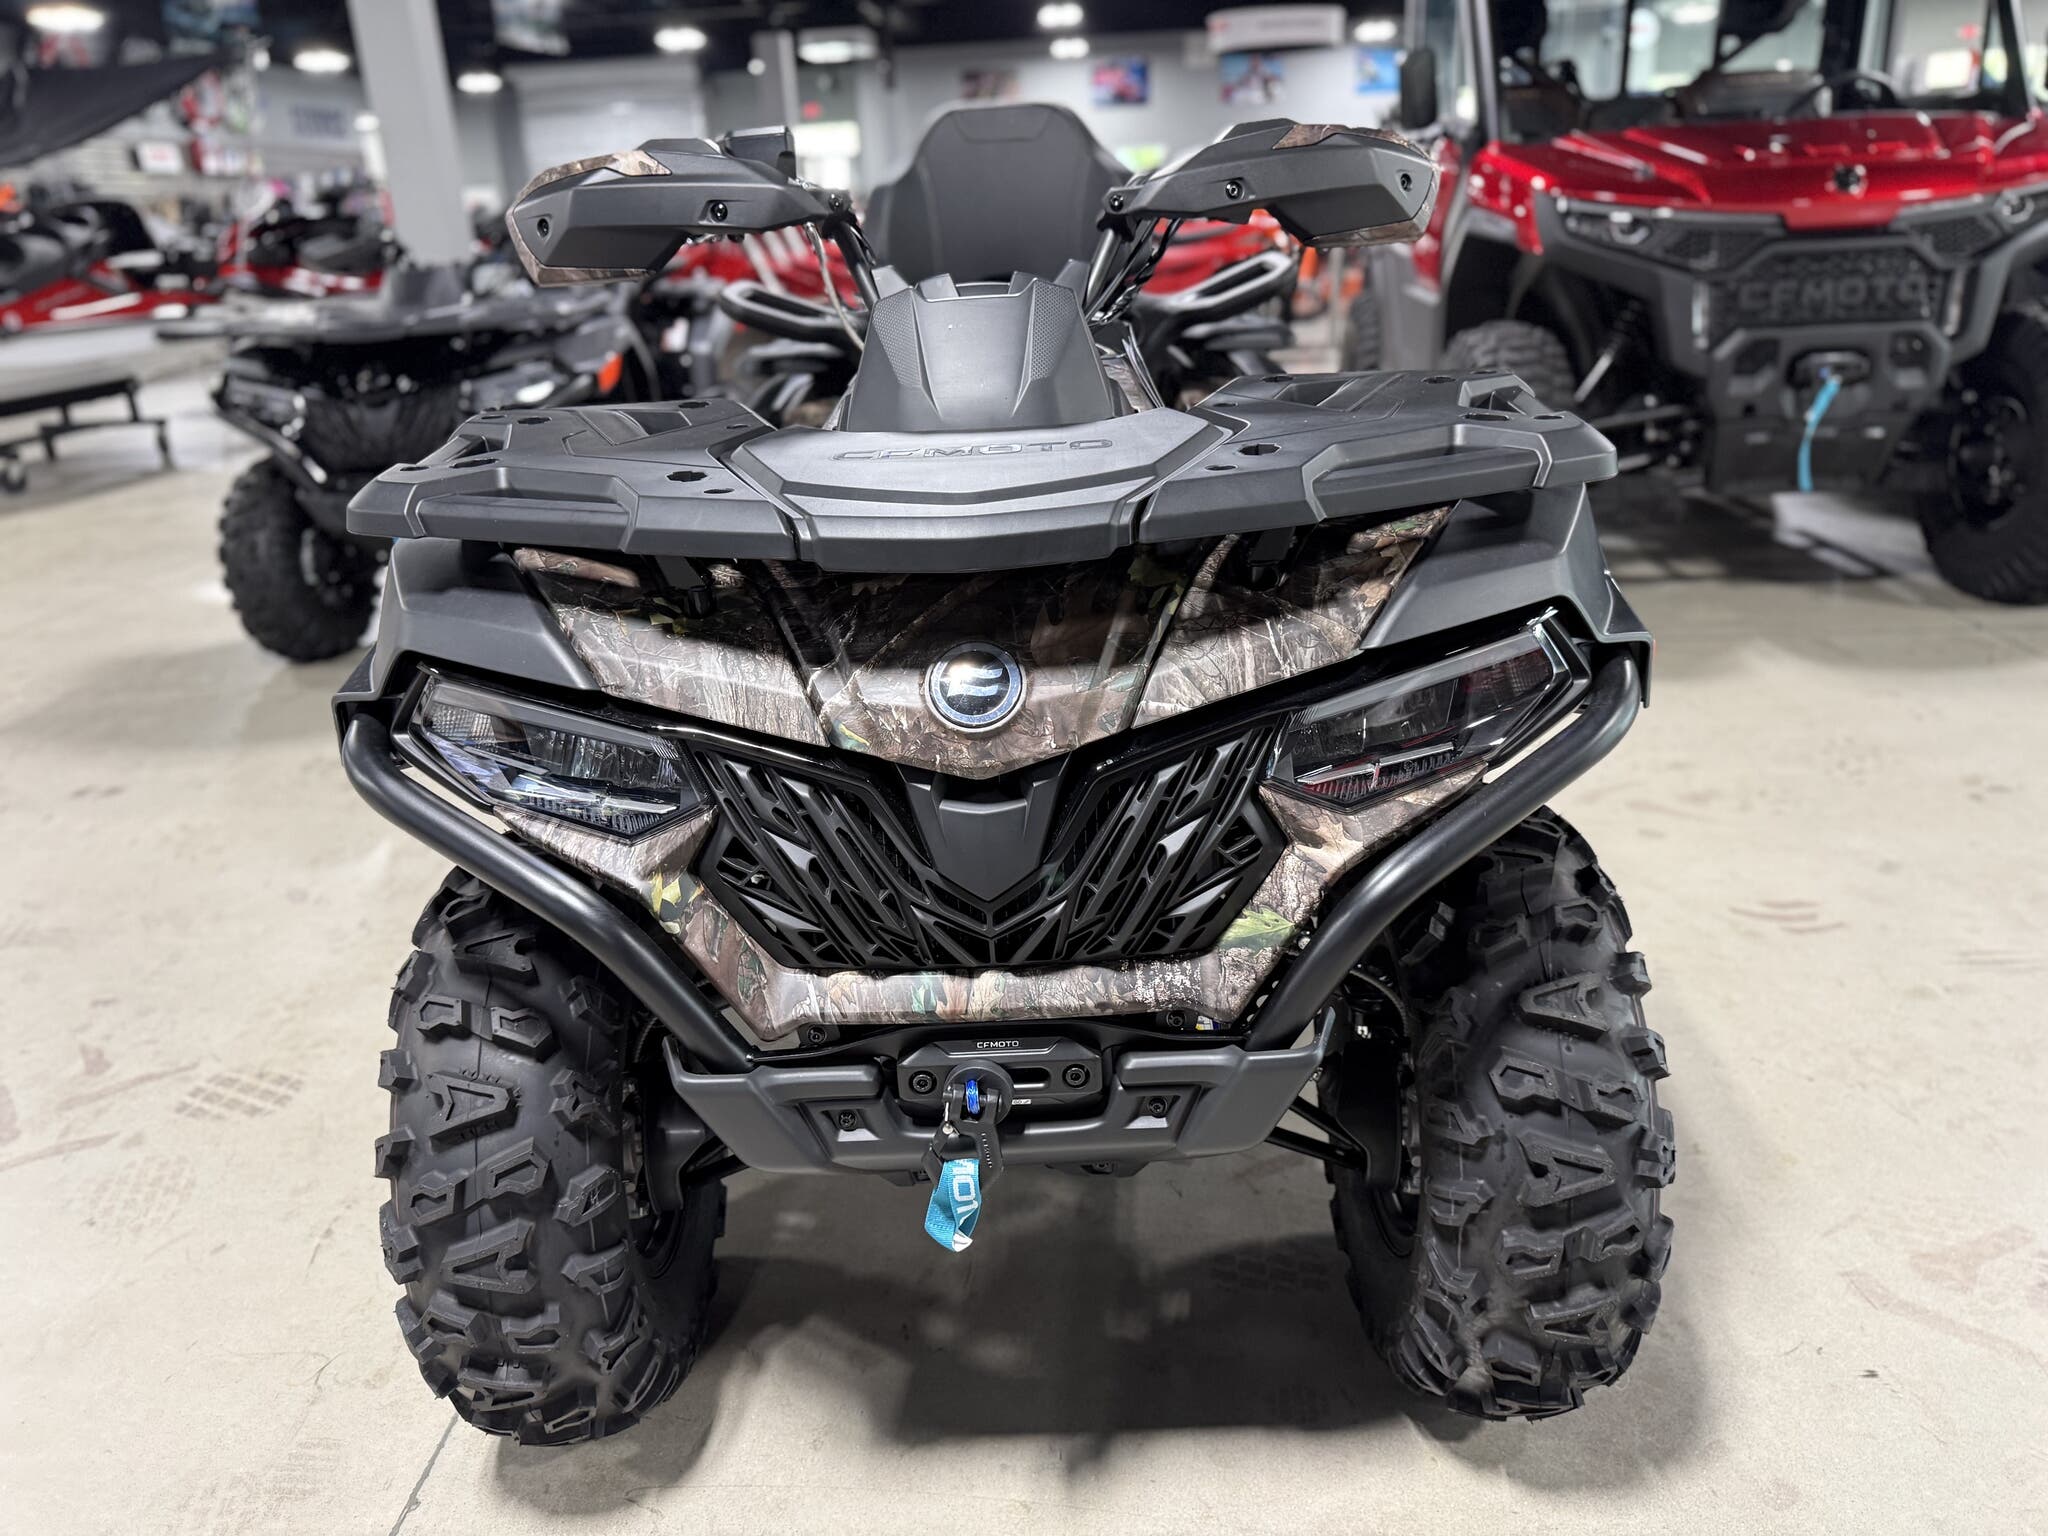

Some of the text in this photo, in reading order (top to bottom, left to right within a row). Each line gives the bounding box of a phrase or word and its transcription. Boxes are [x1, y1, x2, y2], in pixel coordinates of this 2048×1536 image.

[1739, 274, 1928, 311] CFMOTO
[831, 439, 1113, 461] CFMOTO
[976, 1040, 1020, 1049] CFMOTO
